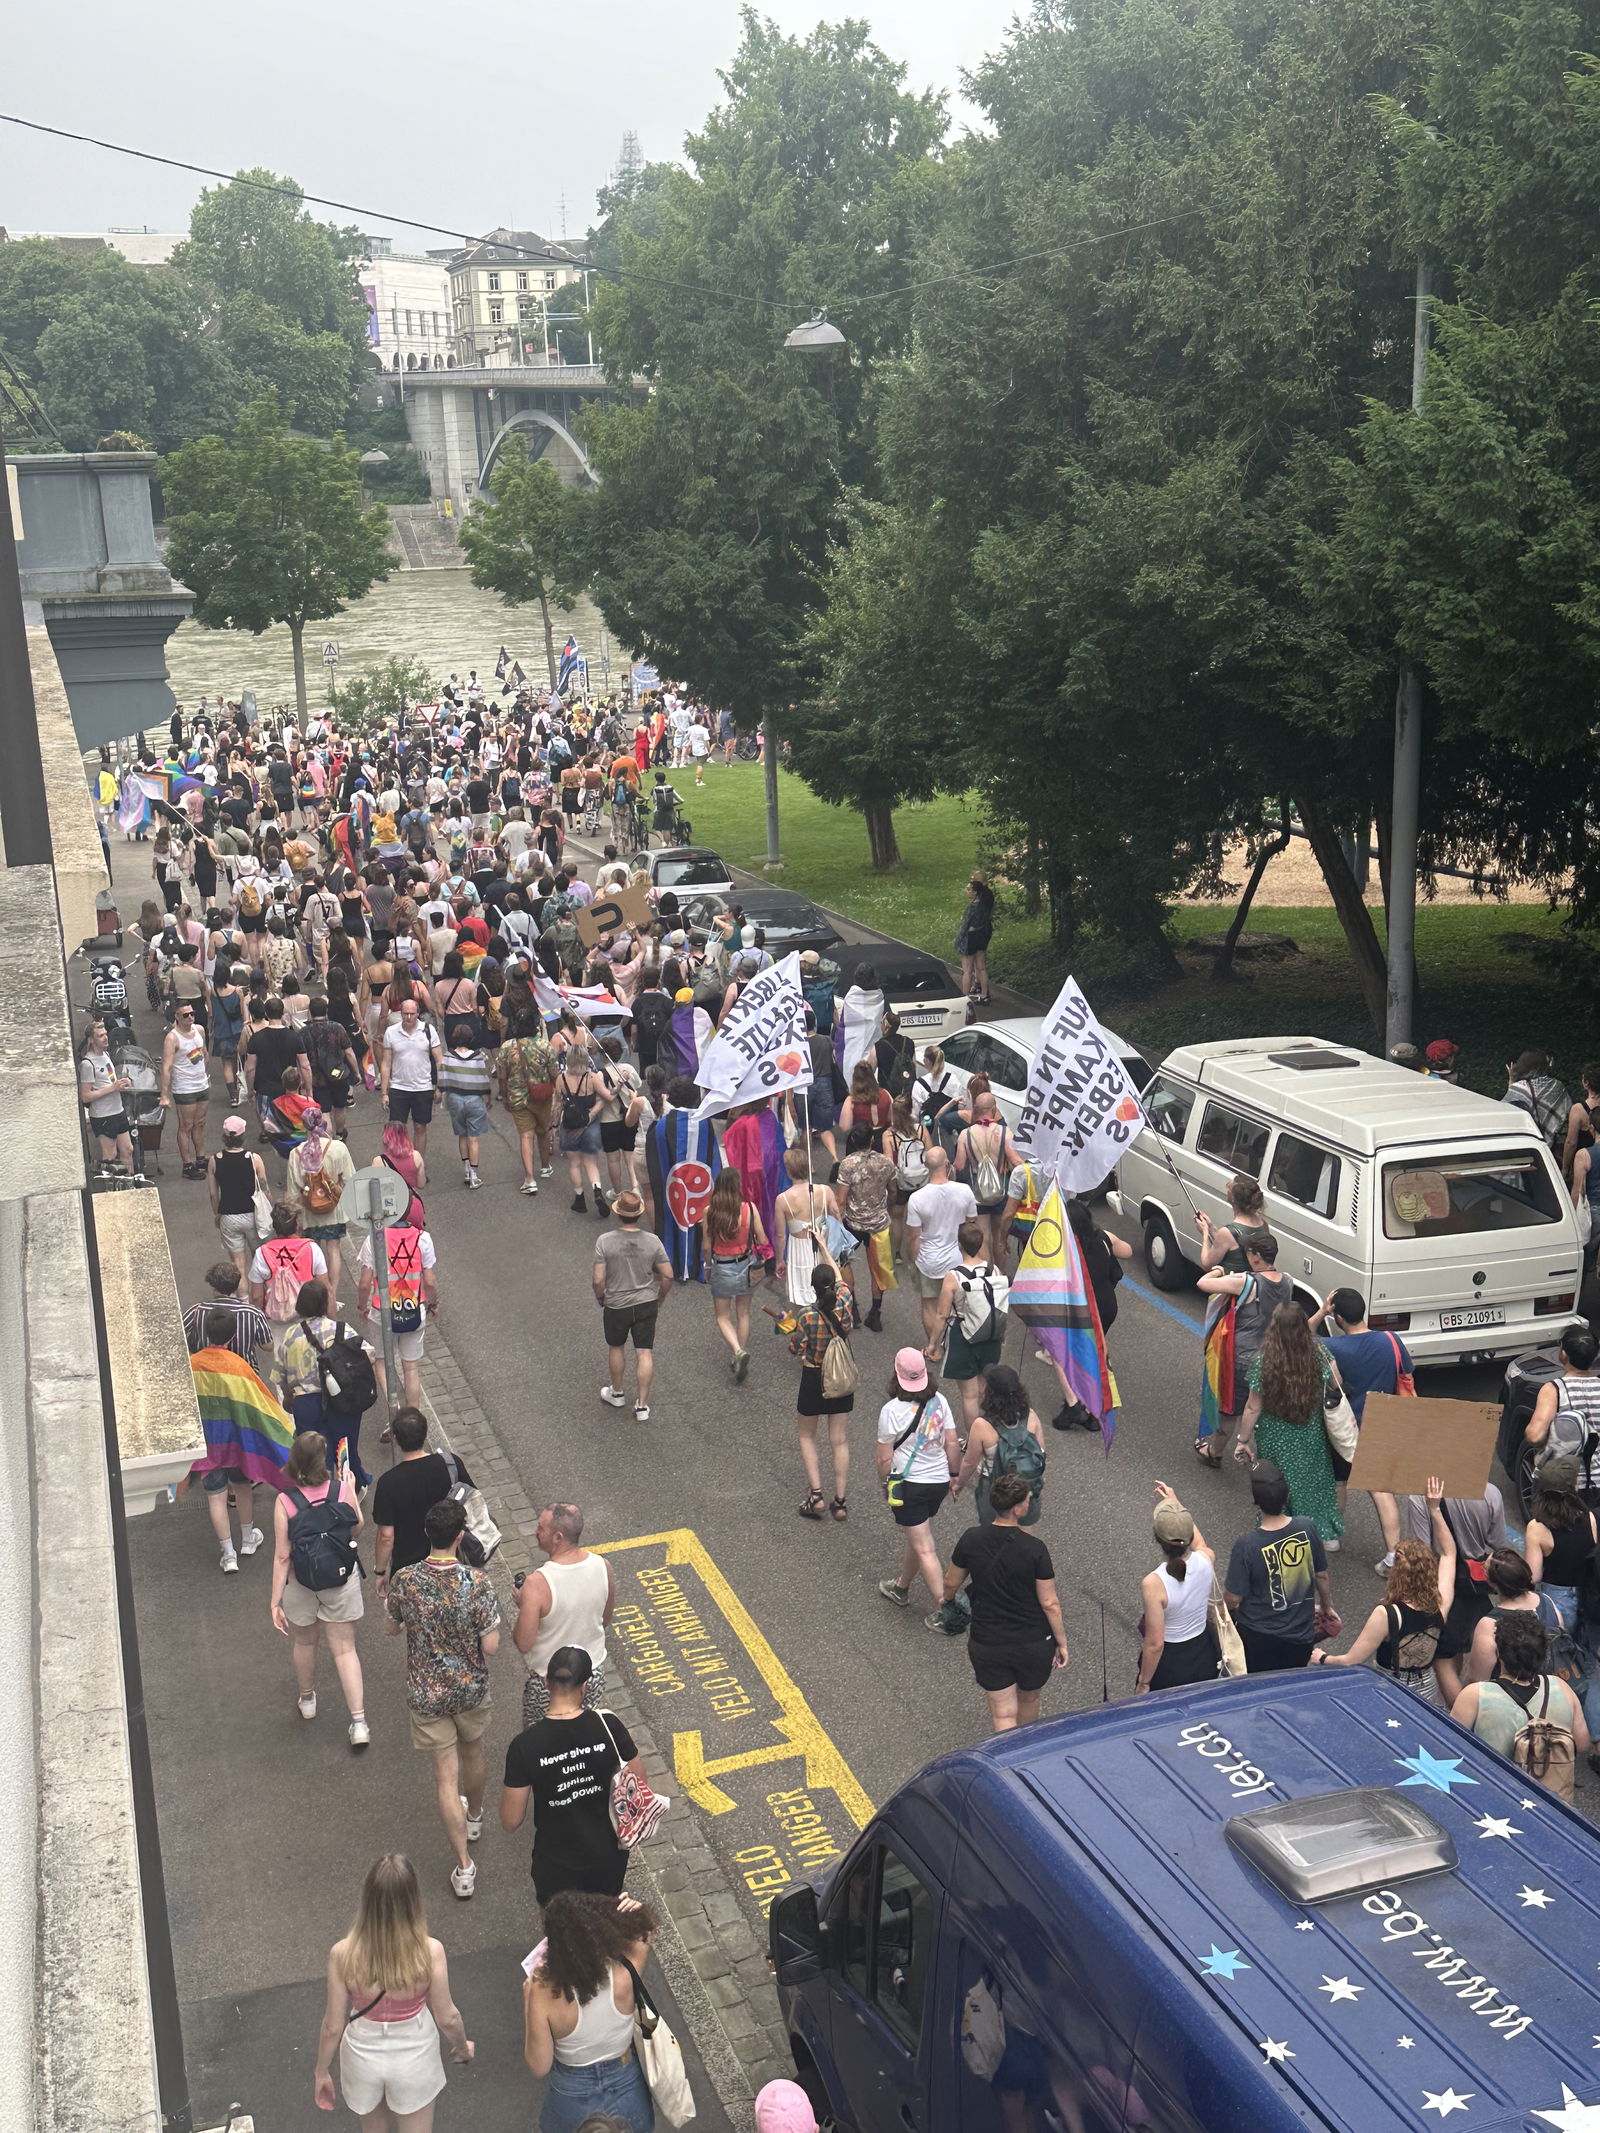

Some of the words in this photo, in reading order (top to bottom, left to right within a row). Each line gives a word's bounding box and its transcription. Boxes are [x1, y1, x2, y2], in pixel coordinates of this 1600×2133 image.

[636, 1564, 711, 1642] ANHÄNGER
[680, 1645, 729, 1675] MIT
[701, 1676, 756, 1722] VELO
[539, 1752, 568, 1766] Never
[569, 1746, 591, 1758] give
[593, 1742, 606, 1752] up
[735, 1844, 793, 1918] VELO
